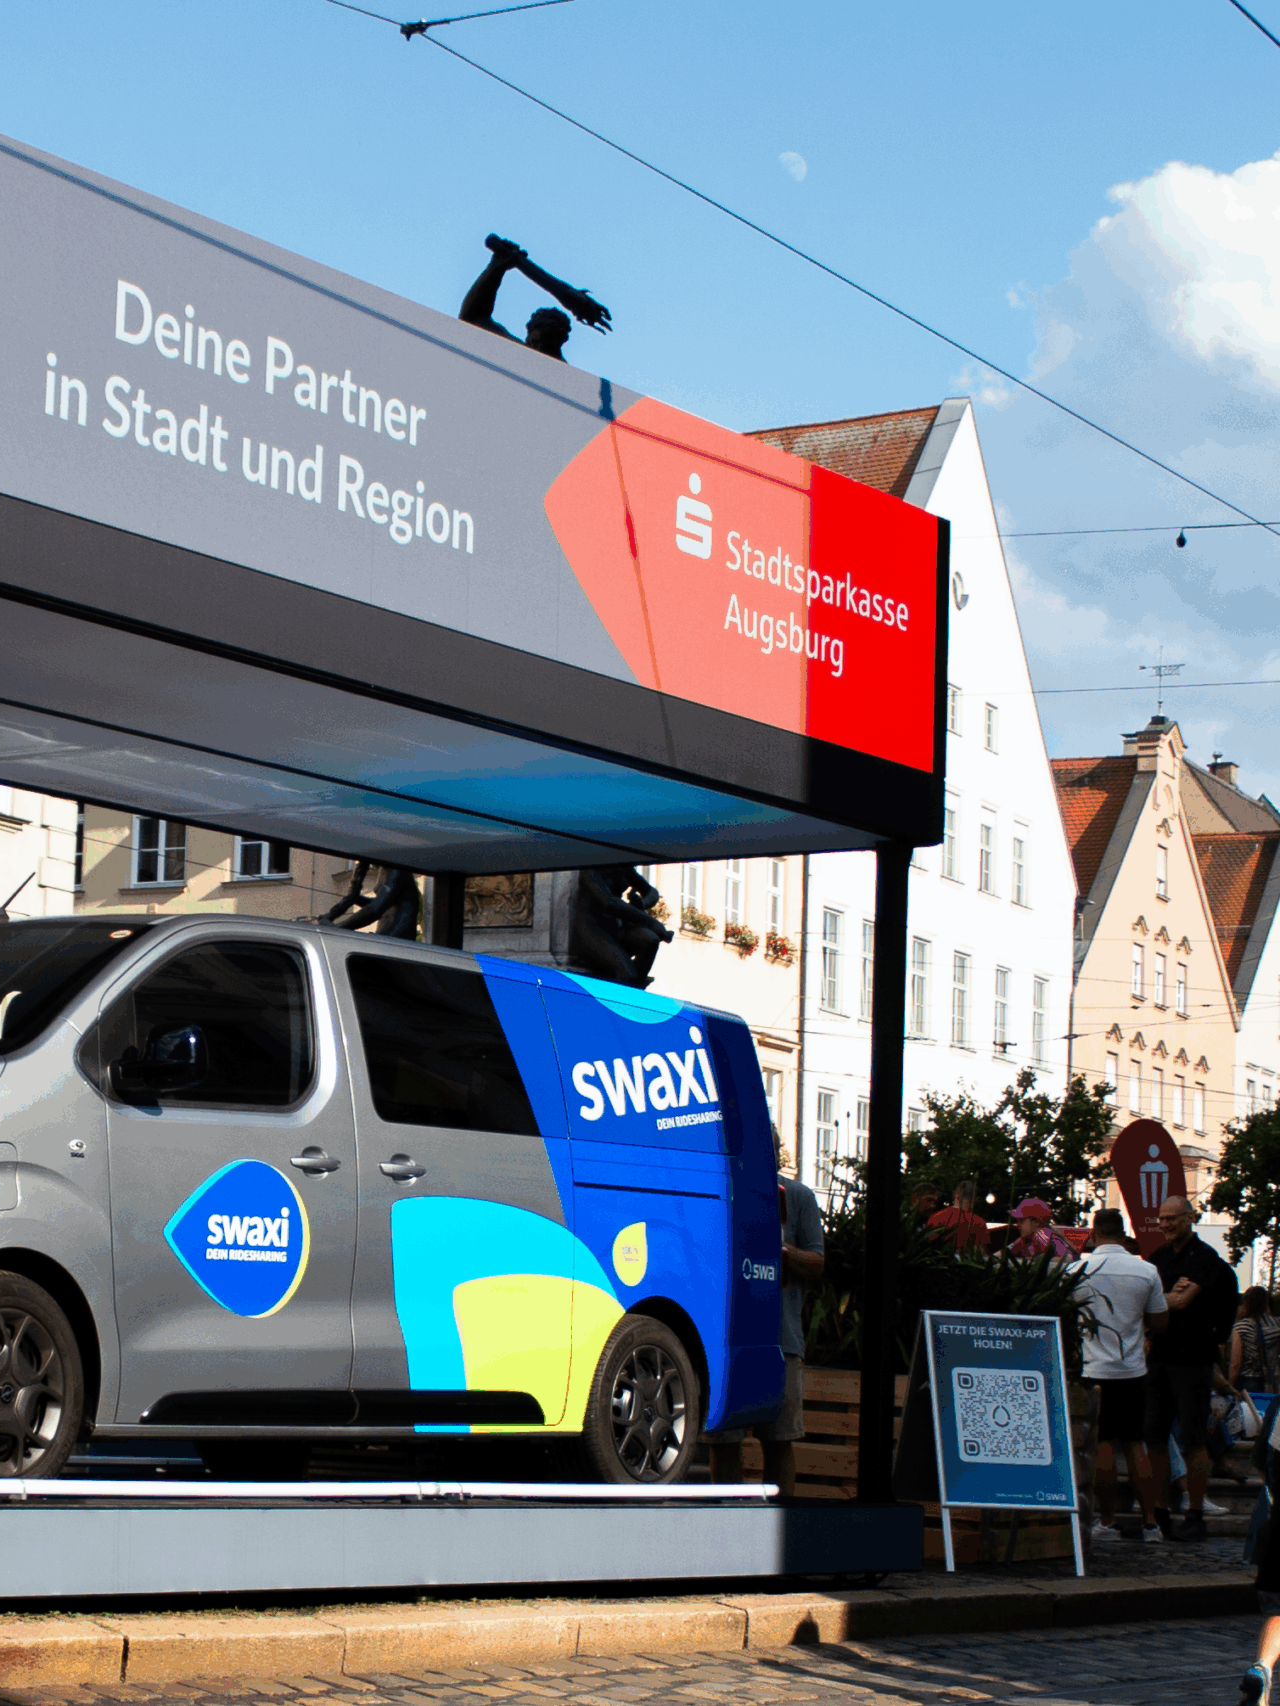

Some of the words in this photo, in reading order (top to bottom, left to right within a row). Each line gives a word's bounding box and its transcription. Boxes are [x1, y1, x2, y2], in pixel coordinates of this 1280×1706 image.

[115, 278, 251, 383] Deine
[265, 335, 427, 446] Partner
[44, 351, 88, 426] in
[102, 374, 229, 472] Stadt
[242, 436, 324, 504] und
[337, 453, 475, 554] Region
[725, 530, 909, 632] Stadtsparkasse
[723, 593, 844, 678] Augsburg
[571, 1025, 719, 1121] swaxi
[656, 1116, 675, 1131] DEIN
[675, 1110, 723, 1128] RIDESHARING
[206, 1206, 290, 1248] swaxi
[206, 1248, 229, 1261] DEIN
[229, 1249, 288, 1263] RIDESHARING
[752, 1263, 776, 1282] swa
[937, 1324, 968, 1335] JETZT
[968, 1326, 987, 1336] DIE
[988, 1327, 1047, 1339] SWAXI-APP
[973, 1338, 1013, 1350] HOLEN!
